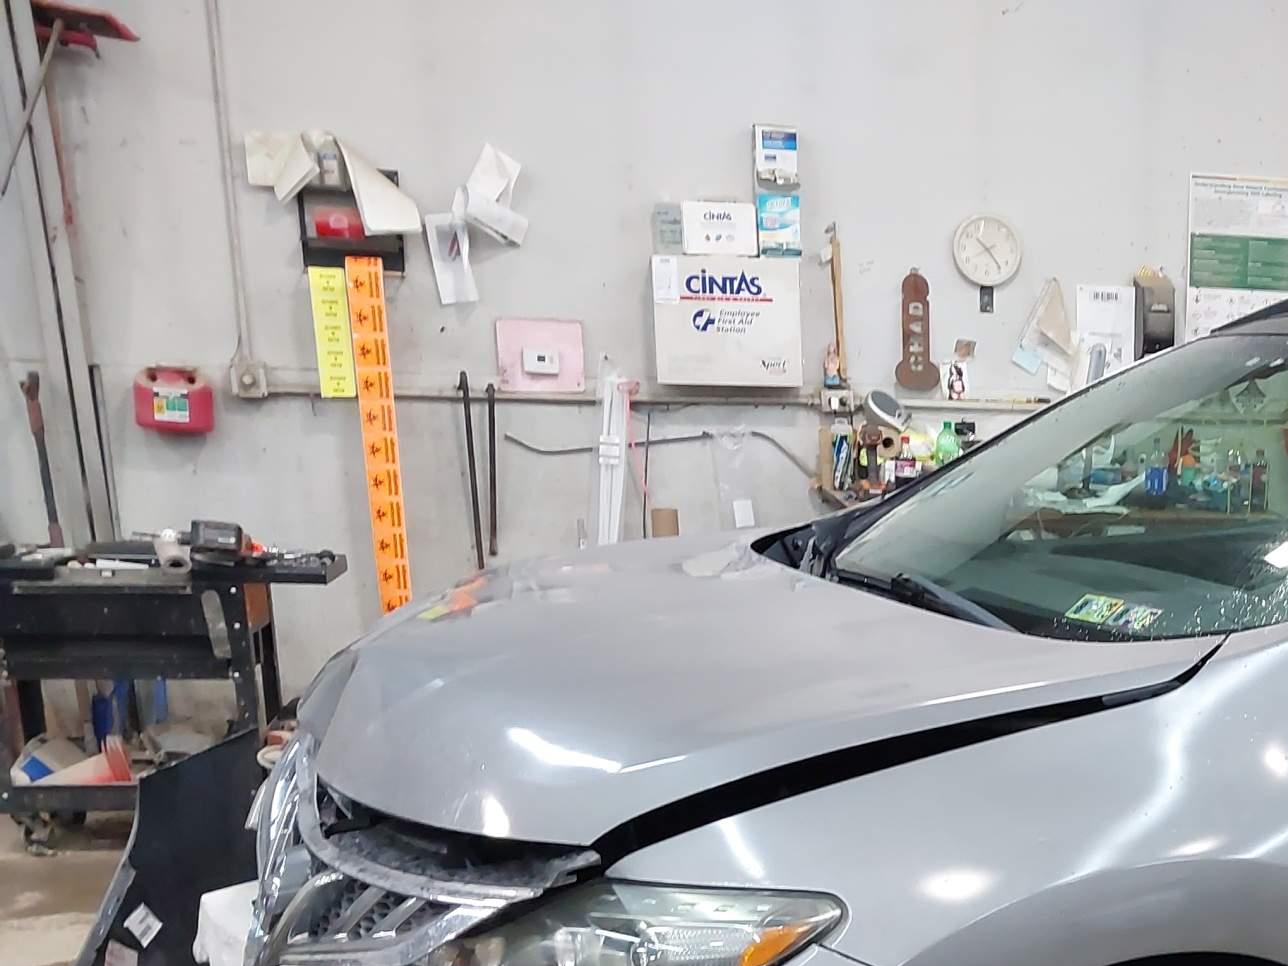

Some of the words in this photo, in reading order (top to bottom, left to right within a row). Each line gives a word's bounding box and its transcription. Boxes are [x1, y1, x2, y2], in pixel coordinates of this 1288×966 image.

[685, 269, 763, 296] CINTAS
[719, 309, 761, 318] Employee
[716, 326, 747, 334] Station
